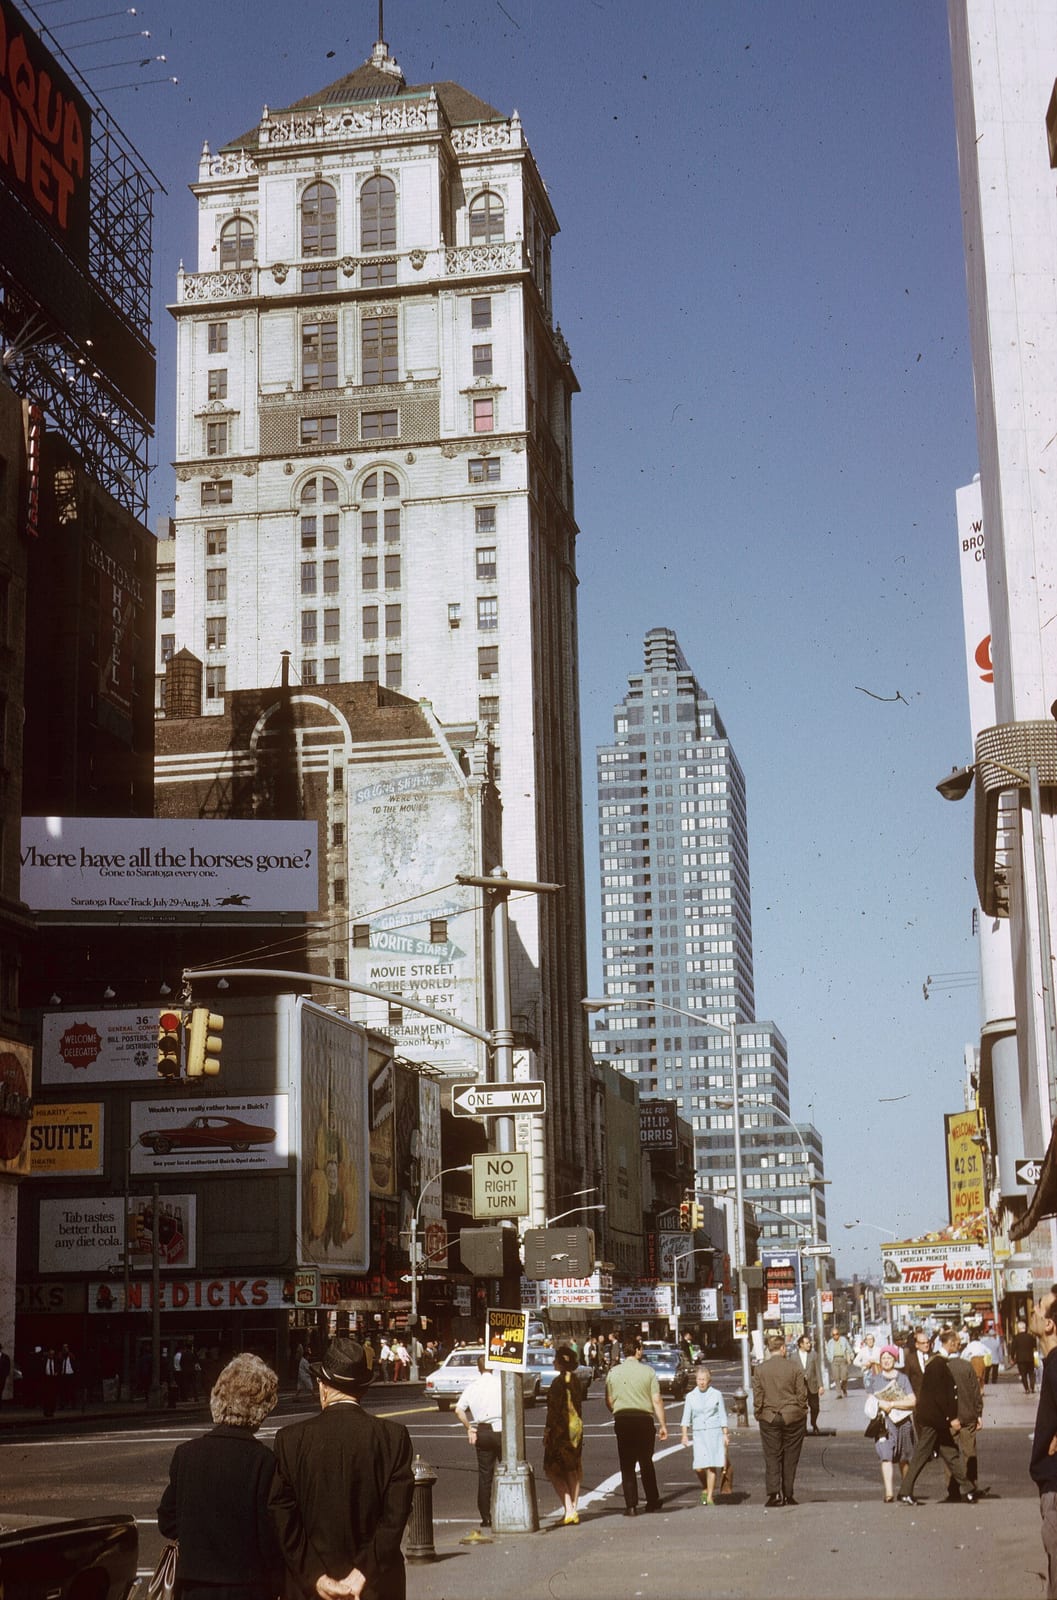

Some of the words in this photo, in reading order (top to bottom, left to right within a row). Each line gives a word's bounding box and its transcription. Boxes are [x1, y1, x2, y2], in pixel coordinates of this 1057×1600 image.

[111, 583, 121, 687] HOTEL
[371, 806, 381, 814] TO
[383, 805, 397, 813] THE
[80, 847, 125, 867] have
[129, 847, 152, 867] all
[154, 847, 186, 868] the
[189, 847, 253, 868] horses
[256, 849, 312, 872] gone?
[99, 868, 126, 877] Gone
[126, 869, 135, 877] to
[136, 868, 174, 878] Saratoga
[71, 897, 108, 907] Saratoga
[152, 898, 168, 908] July
[369, 932, 414, 952] VORITE
[370, 966, 406, 978] MOVIE
[411, 964, 454, 976] STREET
[386, 980, 405, 990] THE
[426, 994, 454, 1003] BEST
[64, 1034, 97, 1044] WELCOME
[64, 1047, 97, 1057] DELEGATES
[467, 1093, 494, 1106] ONE
[511, 1091, 538, 1103] WAY
[36, 1109, 66, 1117] HILARITY
[30, 1124, 92, 1151] SUITE
[487, 1160, 514, 1175] NO
[954, 1157, 965, 1174] 42
[967, 1156, 978, 1173] ST.
[485, 1180, 518, 1193] RIGHT
[486, 1195, 516, 1208] TURN
[955, 1191, 980, 1208] MOVIE
[62, 1212, 82, 1223] Tab
[84, 1212, 115, 1222] tastes
[59, 1224, 89, 1235] better
[92, 1224, 117, 1234] than
[55, 1239, 74, 1249] any
[76, 1236, 95, 1247] diet
[98, 1236, 122, 1246] cola.
[127, 1279, 269, 1308] NEDICKS
[557, 1295, 595, 1303] TRUMPET
[686, 1304, 711, 1312] BOOM
[490, 1312, 525, 1328] SCHOOLS
[504, 1328, 524, 1343] OPEN
